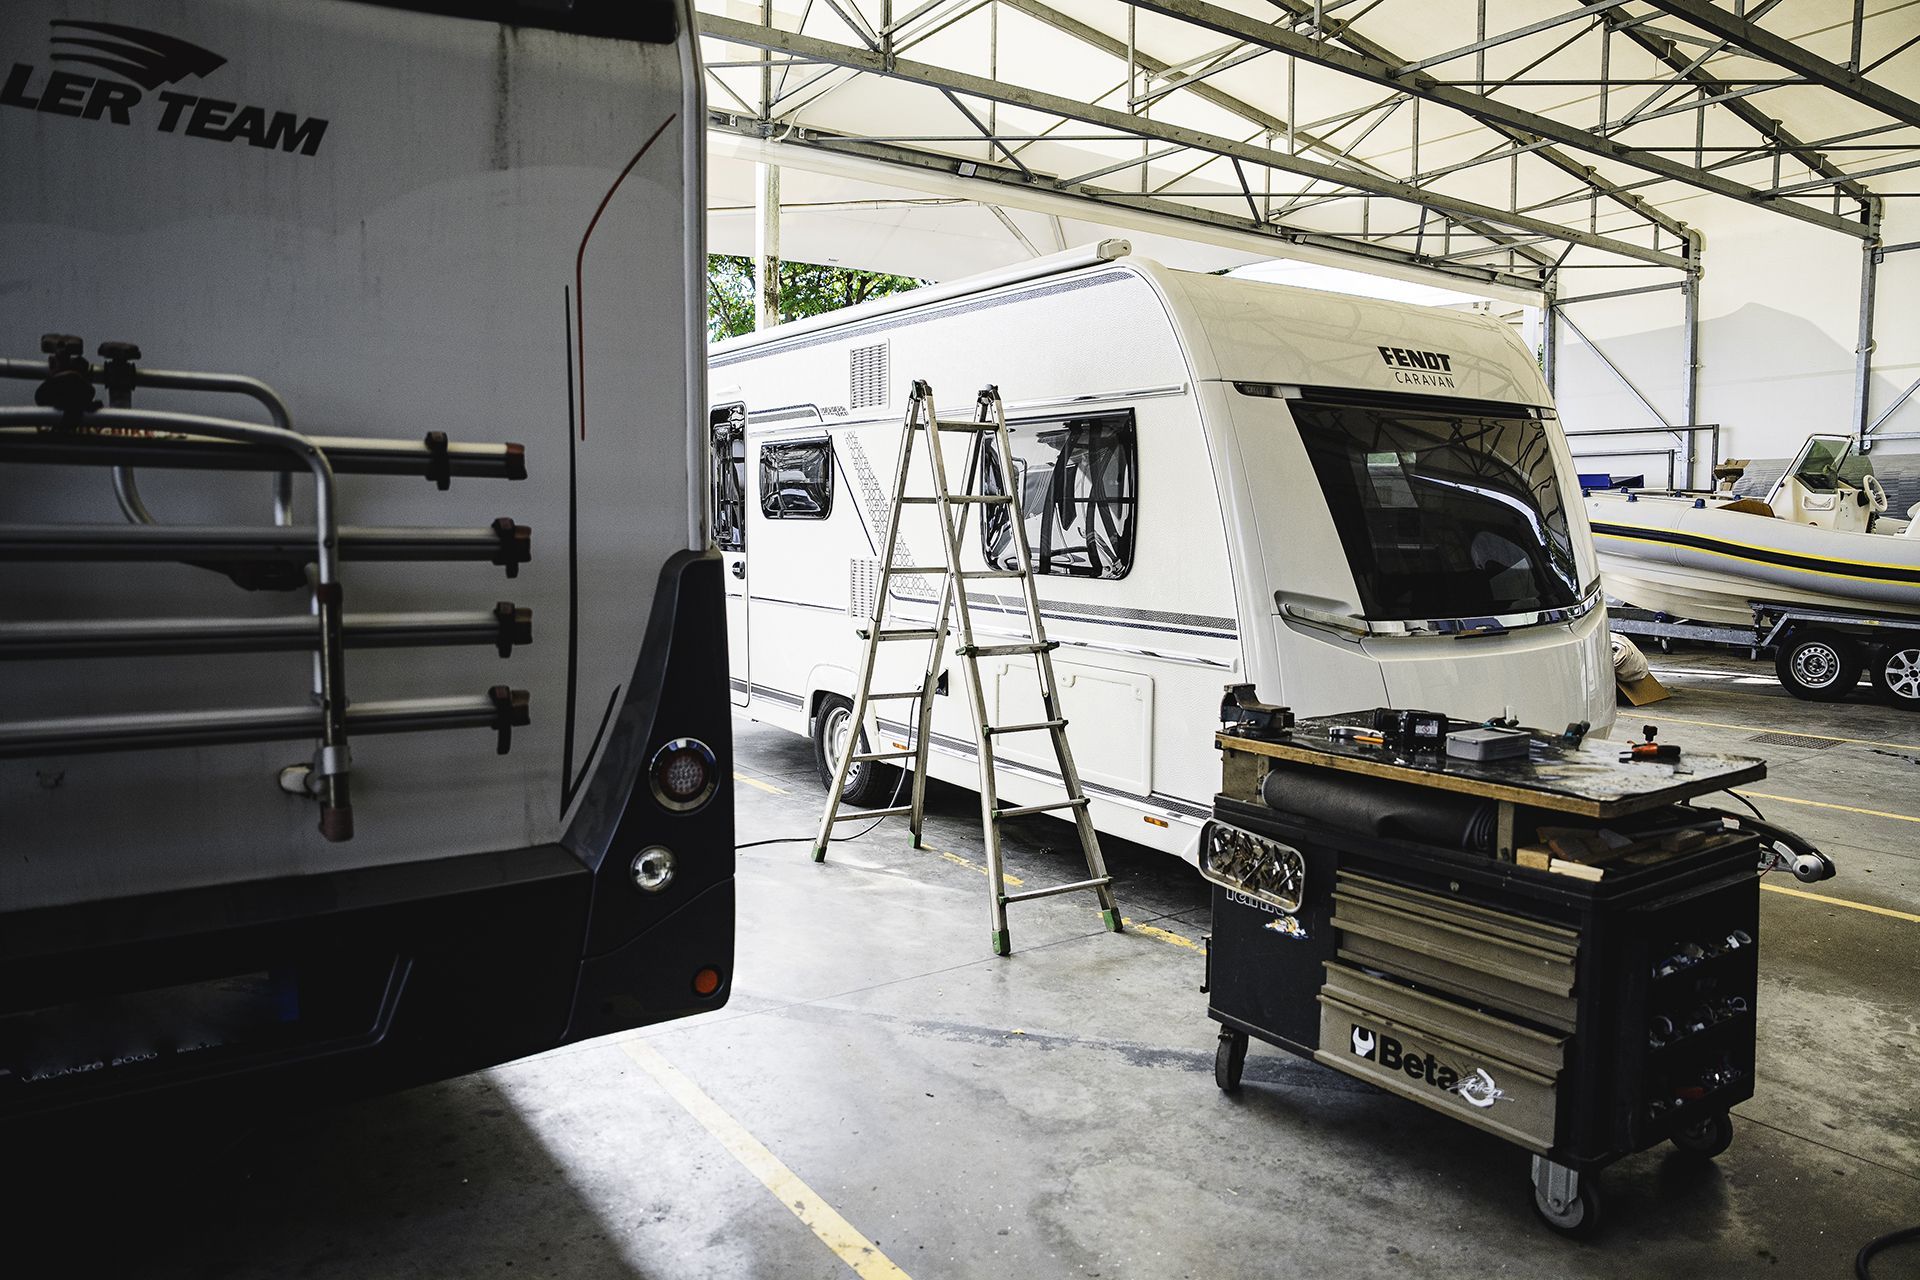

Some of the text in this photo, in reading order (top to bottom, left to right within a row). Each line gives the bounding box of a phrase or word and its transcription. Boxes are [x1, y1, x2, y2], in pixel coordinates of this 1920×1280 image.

[0, 63, 329, 157] LER TEAM
[1377, 346, 1451, 372] FENDT
[1395, 372, 1455, 388] CARAVAN
[1379, 1034, 1459, 1095] Beta
